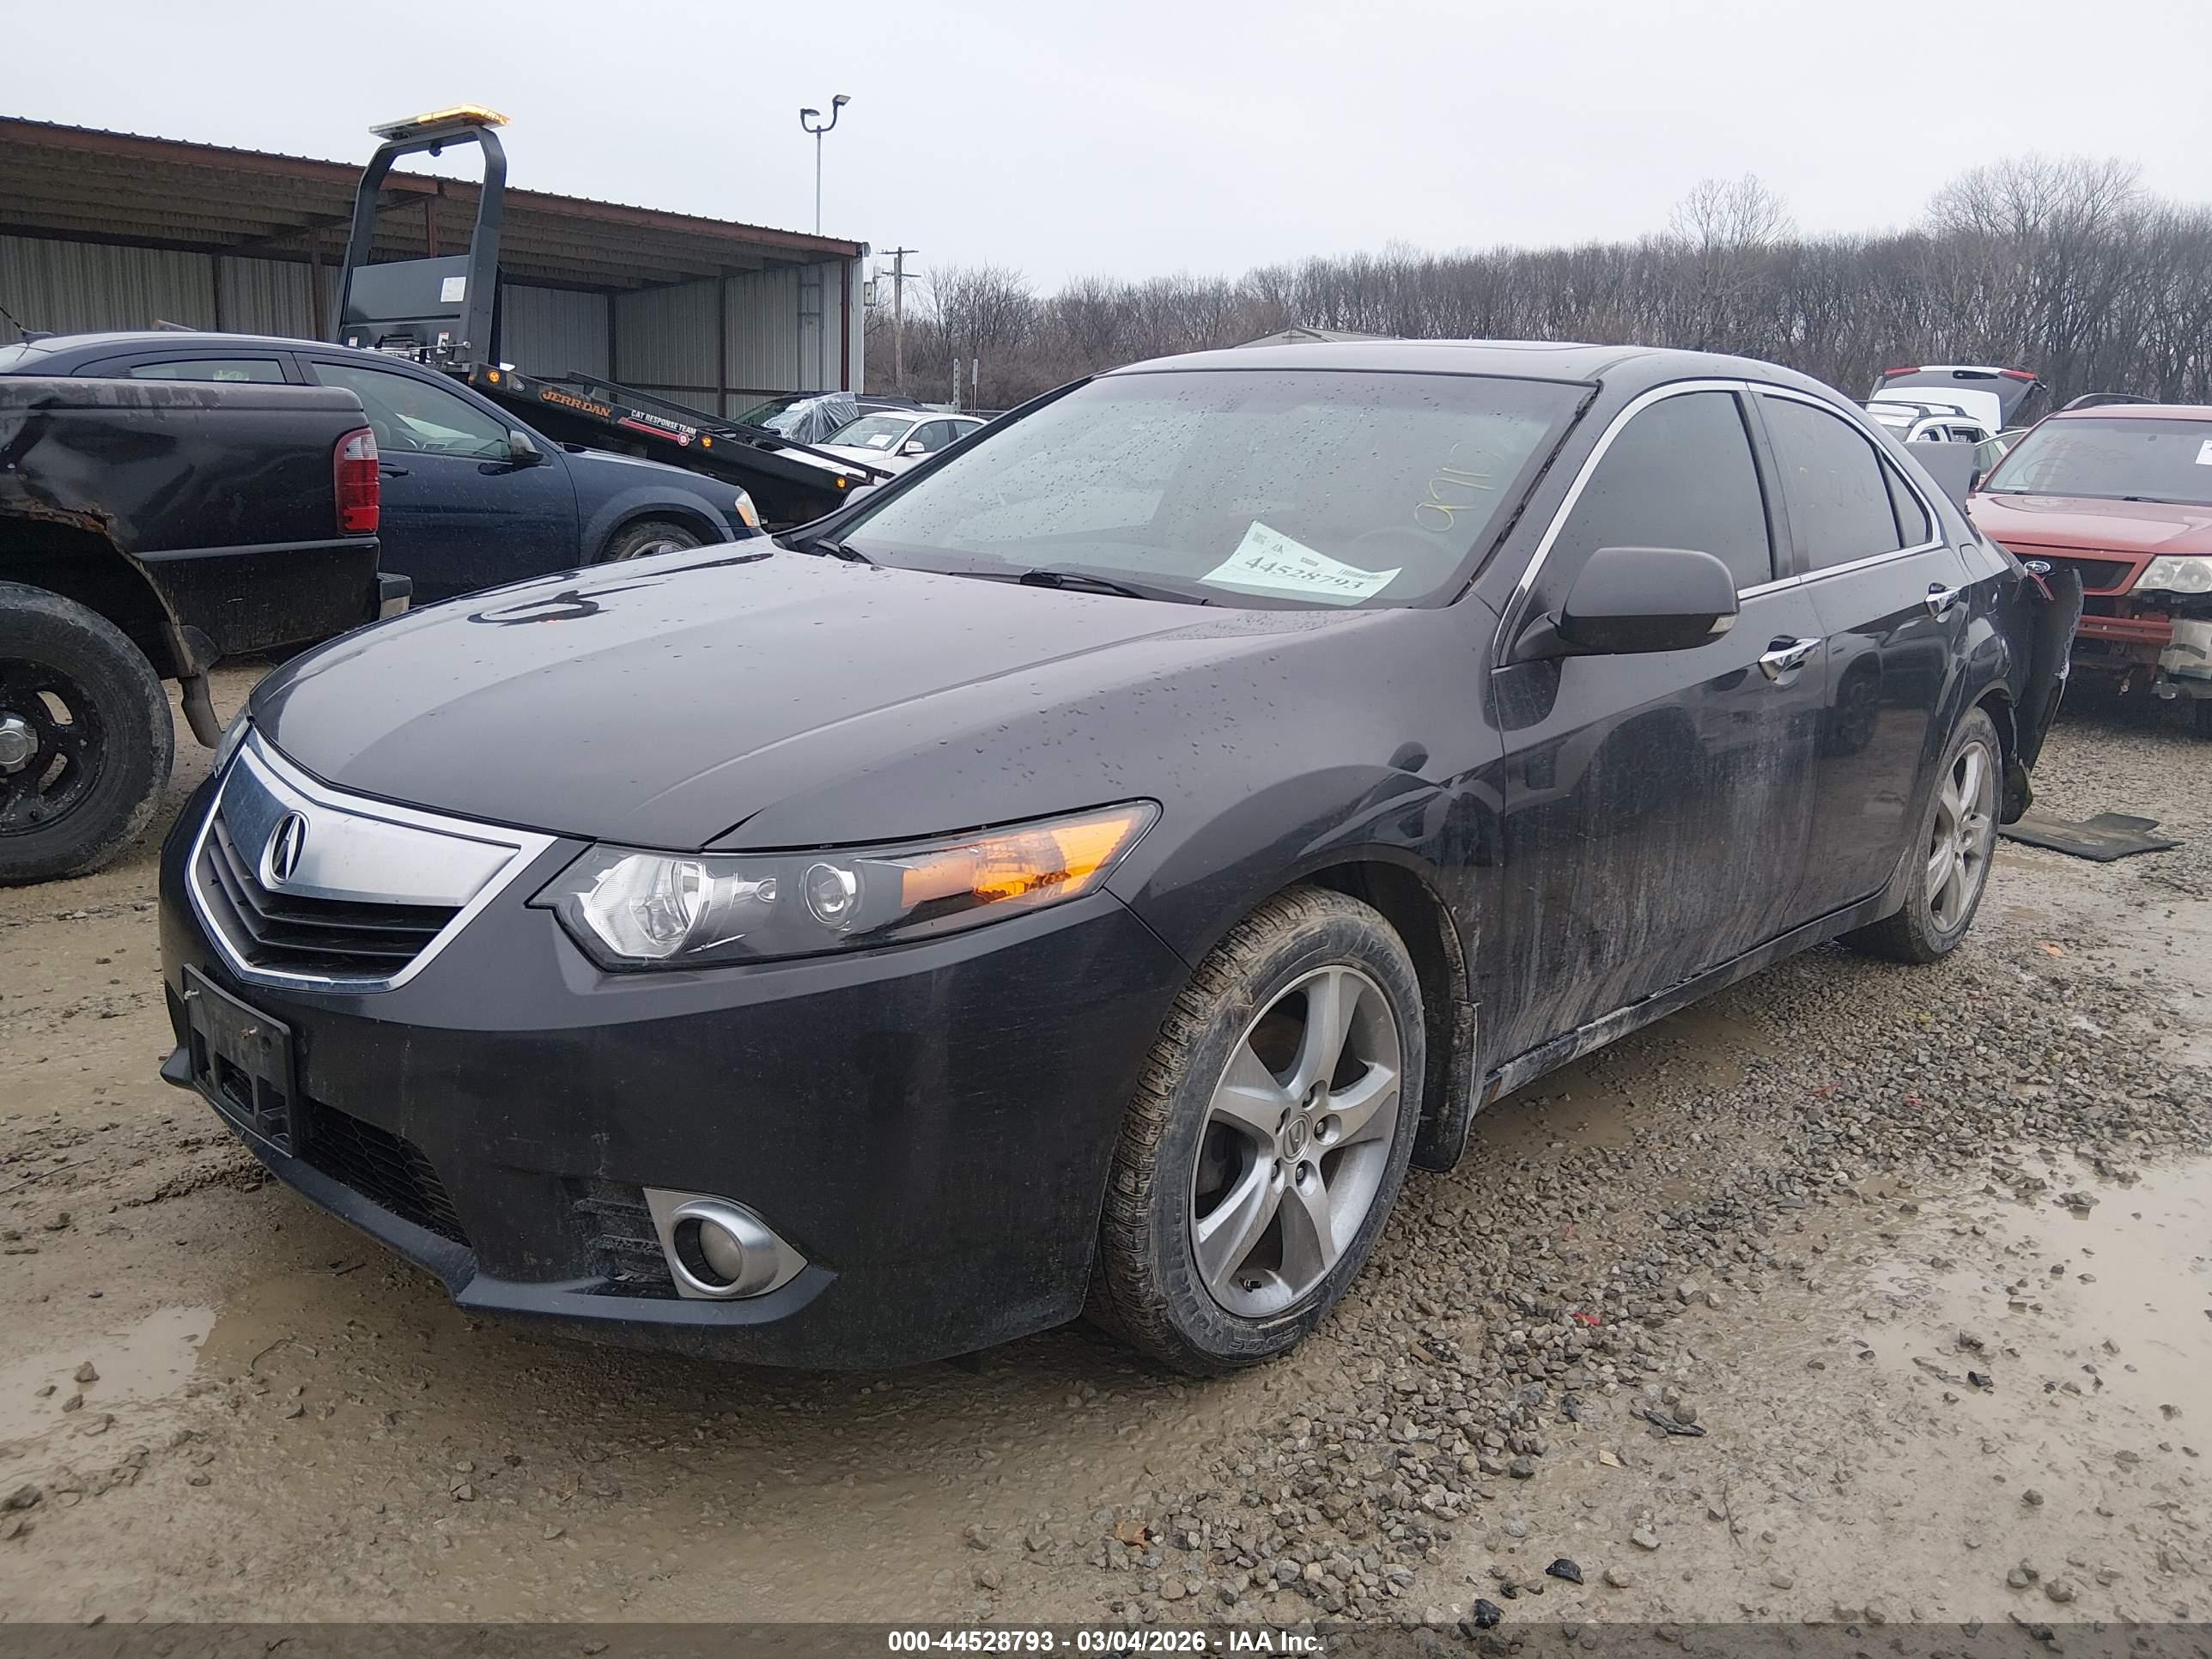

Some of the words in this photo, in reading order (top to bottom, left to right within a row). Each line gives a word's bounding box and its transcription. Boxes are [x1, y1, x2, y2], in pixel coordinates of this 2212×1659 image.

[631, 409, 645, 420] CAT
[645, 412, 678, 430] RESPONSE
[678, 423, 697, 436] TEAM
[1245, 556, 1364, 591] 44528793
